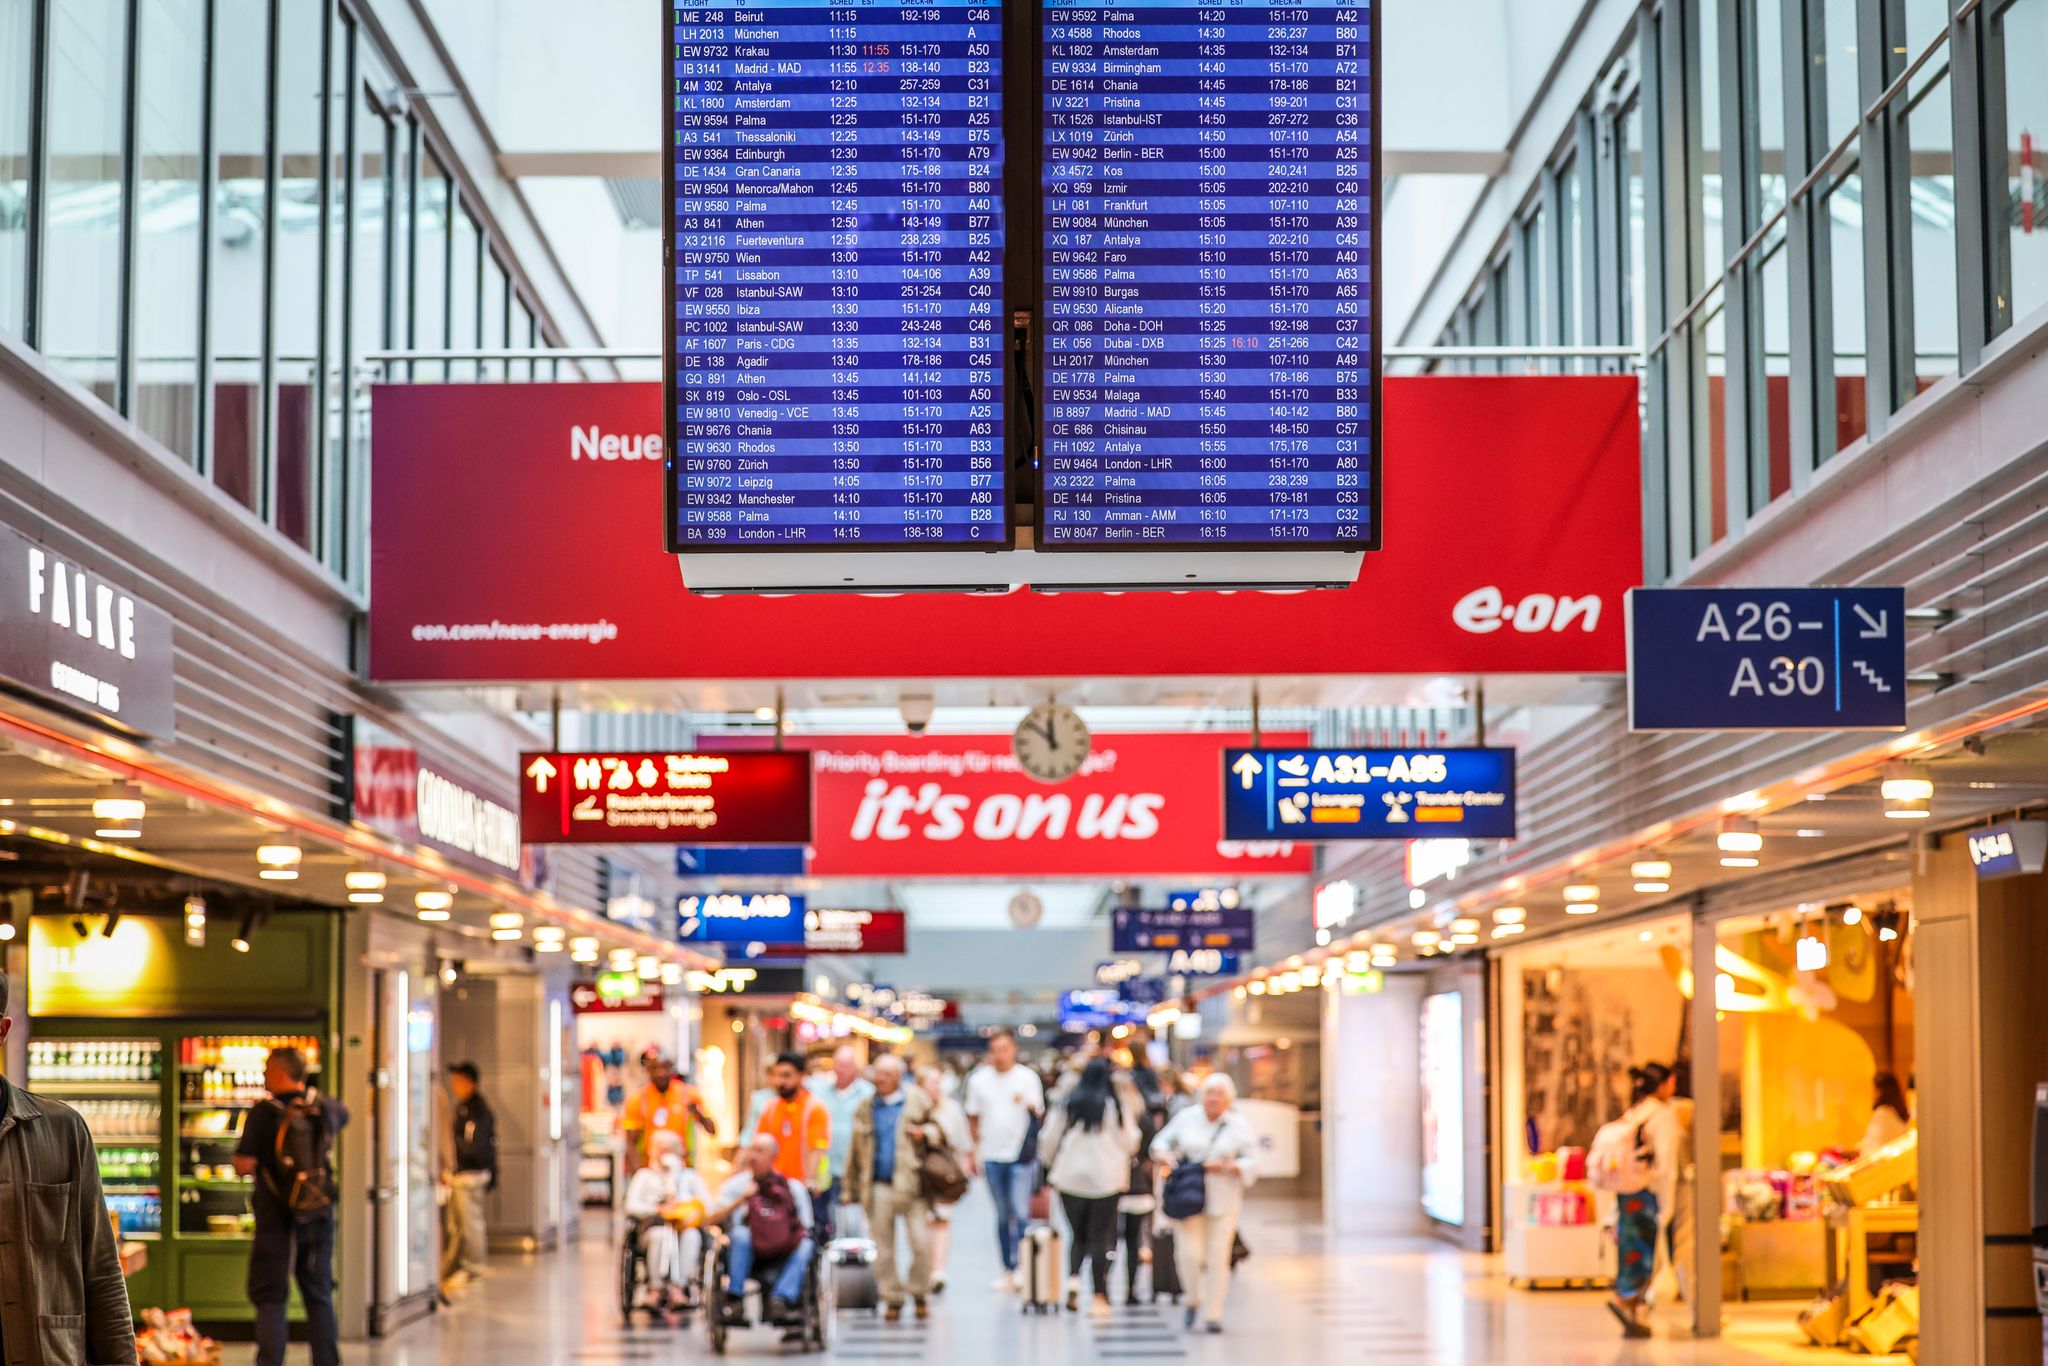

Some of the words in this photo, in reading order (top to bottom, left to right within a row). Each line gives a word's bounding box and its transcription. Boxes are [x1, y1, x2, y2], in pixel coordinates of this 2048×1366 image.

[683, 11, 700, 23] ME
[704, 11, 724, 23] 248
[734, 10, 764, 23] Beirut
[829, 9, 857, 22] 11:15
[900, 9, 941, 21] 192-196
[967, 9, 990, 22] C46
[1051, 10, 1070, 22] EW
[1071, 10, 1097, 22] 9592
[1103, 10, 1135, 22] Palma
[1198, 10, 1226, 22] 14:20
[1268, 10, 1309, 22] 151-170
[1335, 9, 1358, 22] A42
[683, 45, 702, 58] EW
[703, 45, 729, 57] 9732
[734, 45, 770, 57] Krakau
[830, 44, 857, 56] 11:30
[862, 44, 890, 56] 11:55
[900, 44, 941, 56] 151-170
[967, 43, 990, 56] A50
[1052, 62, 1070, 74] EW
[1071, 62, 1097, 73] 9334
[1103, 61, 1162, 76] Birmingham
[1198, 61, 1226, 73] 14:40
[1269, 61, 1309, 73] 151-170
[1335, 61, 1358, 74] A72
[683, 80, 699, 92] 4M
[704, 80, 723, 92] 302
[734, 79, 772, 94] Antalya
[830, 79, 858, 91] 12:10
[899, 78, 941, 91] 257-259
[967, 78, 989, 91] C31
[1051, 113, 1066, 125] TK
[1069, 113, 1094, 125] 1526
[1103, 113, 1163, 125] Istanbul-IST
[1198, 113, 1226, 125] 14:50
[1268, 113, 1309, 125] 267-272
[1335, 113, 1359, 126] C36
[683, 131, 698, 144] A3
[703, 131, 721, 143] 541
[735, 130, 796, 143] Thessaloniki
[830, 130, 858, 142] 12:25
[900, 129, 941, 142] 143-149
[968, 129, 990, 142] B75
[684, 183, 703, 195] EW
[704, 183, 729, 195] 9504
[735, 182, 814, 195] Menorca/Mahon
[830, 182, 858, 194] 12:45
[901, 181, 942, 193] 151-170
[968, 181, 991, 194] B80
[1051, 182, 1068, 194] XQ
[1073, 182, 1093, 194] 959
[1103, 182, 1128, 194] Izmir
[1198, 181, 1226, 194] 15:05
[1268, 181, 1309, 193] 202-210
[1335, 181, 1359, 194] C40
[1052, 216, 1071, 228] EW
[1072, 216, 1097, 228] 9084
[1104, 216, 1149, 228] München
[1198, 216, 1226, 228] 15:05
[1269, 216, 1309, 228] 151-170
[1335, 216, 1358, 228] A39
[684, 235, 699, 247] X3
[700, 234, 726, 247] 2116
[736, 234, 804, 246] Fuerteventura
[831, 233, 858, 246] 12:50
[900, 233, 941, 247] 238,239
[968, 232, 991, 245] B25
[684, 269, 699, 281] TP
[704, 269, 722, 281] 541
[736, 269, 780, 281] Lissabon
[831, 268, 859, 280] 13:10
[901, 268, 942, 280] 104-106
[968, 267, 991, 280] A39
[1053, 303, 1071, 315] EW
[1072, 303, 1098, 315] 9530
[1104, 303, 1144, 314] Alicante
[1199, 302, 1226, 314] 15:20
[1269, 302, 1309, 314] 151-170
[1335, 302, 1358, 314] A50
[685, 355, 701, 368] DE
[706, 355, 725, 367] 138
[736, 355, 769, 370] Agadir
[831, 354, 859, 366] 13:40
[902, 354, 942, 366] 178-186
[969, 353, 992, 366] C45
[1052, 372, 1068, 384] DE
[1071, 372, 1096, 384] 1778
[1104, 372, 1136, 383] Palma
[1199, 371, 1226, 383] 15:30
[1269, 371, 1309, 383] 178-186
[1336, 371, 1358, 383] B75
[686, 424, 704, 436] EW
[705, 424, 731, 436] 9676
[736, 424, 773, 436] Chania
[832, 423, 860, 435] 13:50
[902, 423, 943, 435] 151-170
[969, 422, 992, 435] A63
[571, 425, 663, 461] Neue
[1053, 441, 1068, 452] FH
[1071, 441, 1096, 452] 1092
[1104, 440, 1142, 455] Antalya
[1199, 440, 1227, 452] 15:55
[1269, 440, 1309, 453] 175,176
[1336, 439, 1358, 452] C31
[687, 493, 705, 505] EW
[706, 493, 732, 505] 9342
[738, 493, 796, 505] Manchester
[833, 492, 860, 504] 14:10
[903, 491, 943, 504] 151-170
[970, 491, 992, 504] A80
[1053, 492, 1069, 504] DE
[1075, 492, 1093, 504] 144
[1105, 492, 1142, 504] Pristina
[1199, 491, 1227, 504] 16:05
[1269, 491, 1308, 503] 179-181
[1336, 491, 1359, 504] C53
[28, 547, 136, 660] FALKE
[1729, 656, 1825, 697] A30
[973, 793, 1072, 841] on
[1075, 792, 1165, 841] us
